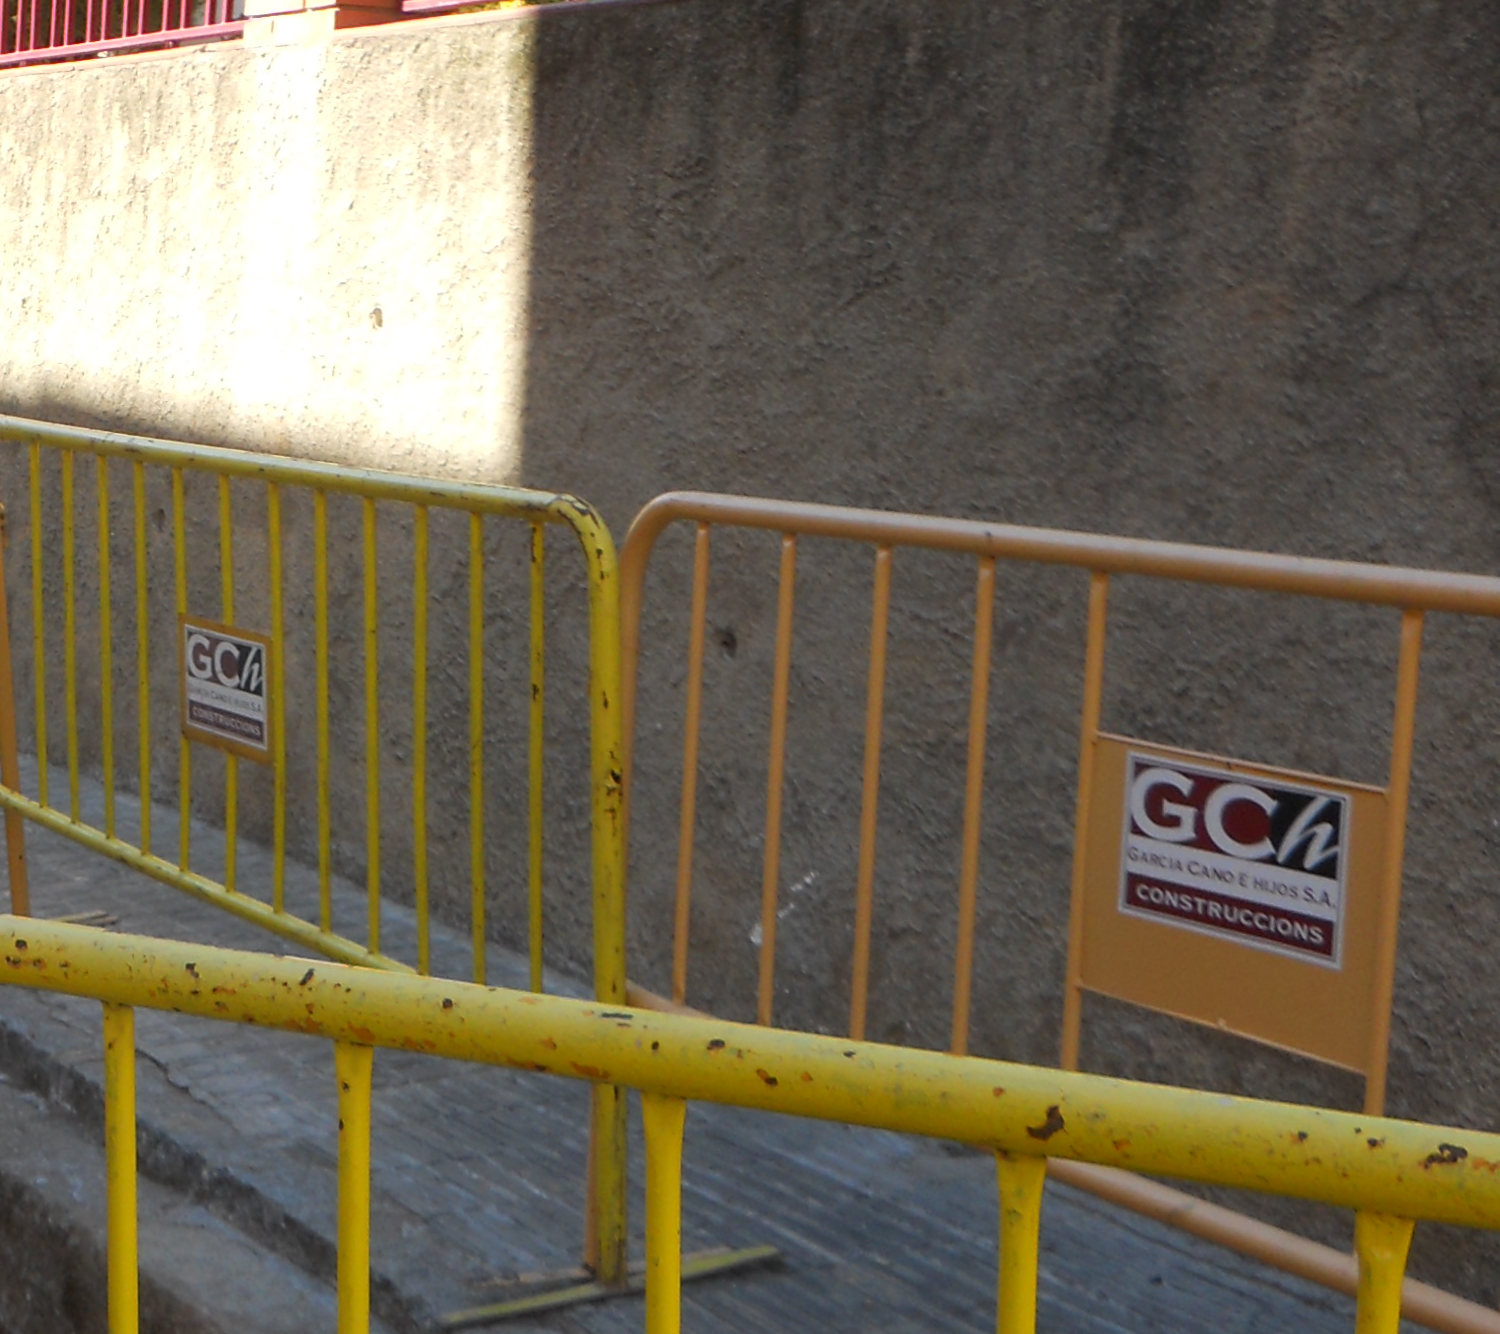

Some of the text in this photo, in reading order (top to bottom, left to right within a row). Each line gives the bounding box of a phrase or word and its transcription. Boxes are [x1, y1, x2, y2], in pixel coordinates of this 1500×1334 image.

[1130, 767, 1341, 871] GCh
[1126, 847, 1338, 909] GARCIA CANO E HIJOS S.A.
[1135, 883, 1325, 945] CONSTRUCCIONS
